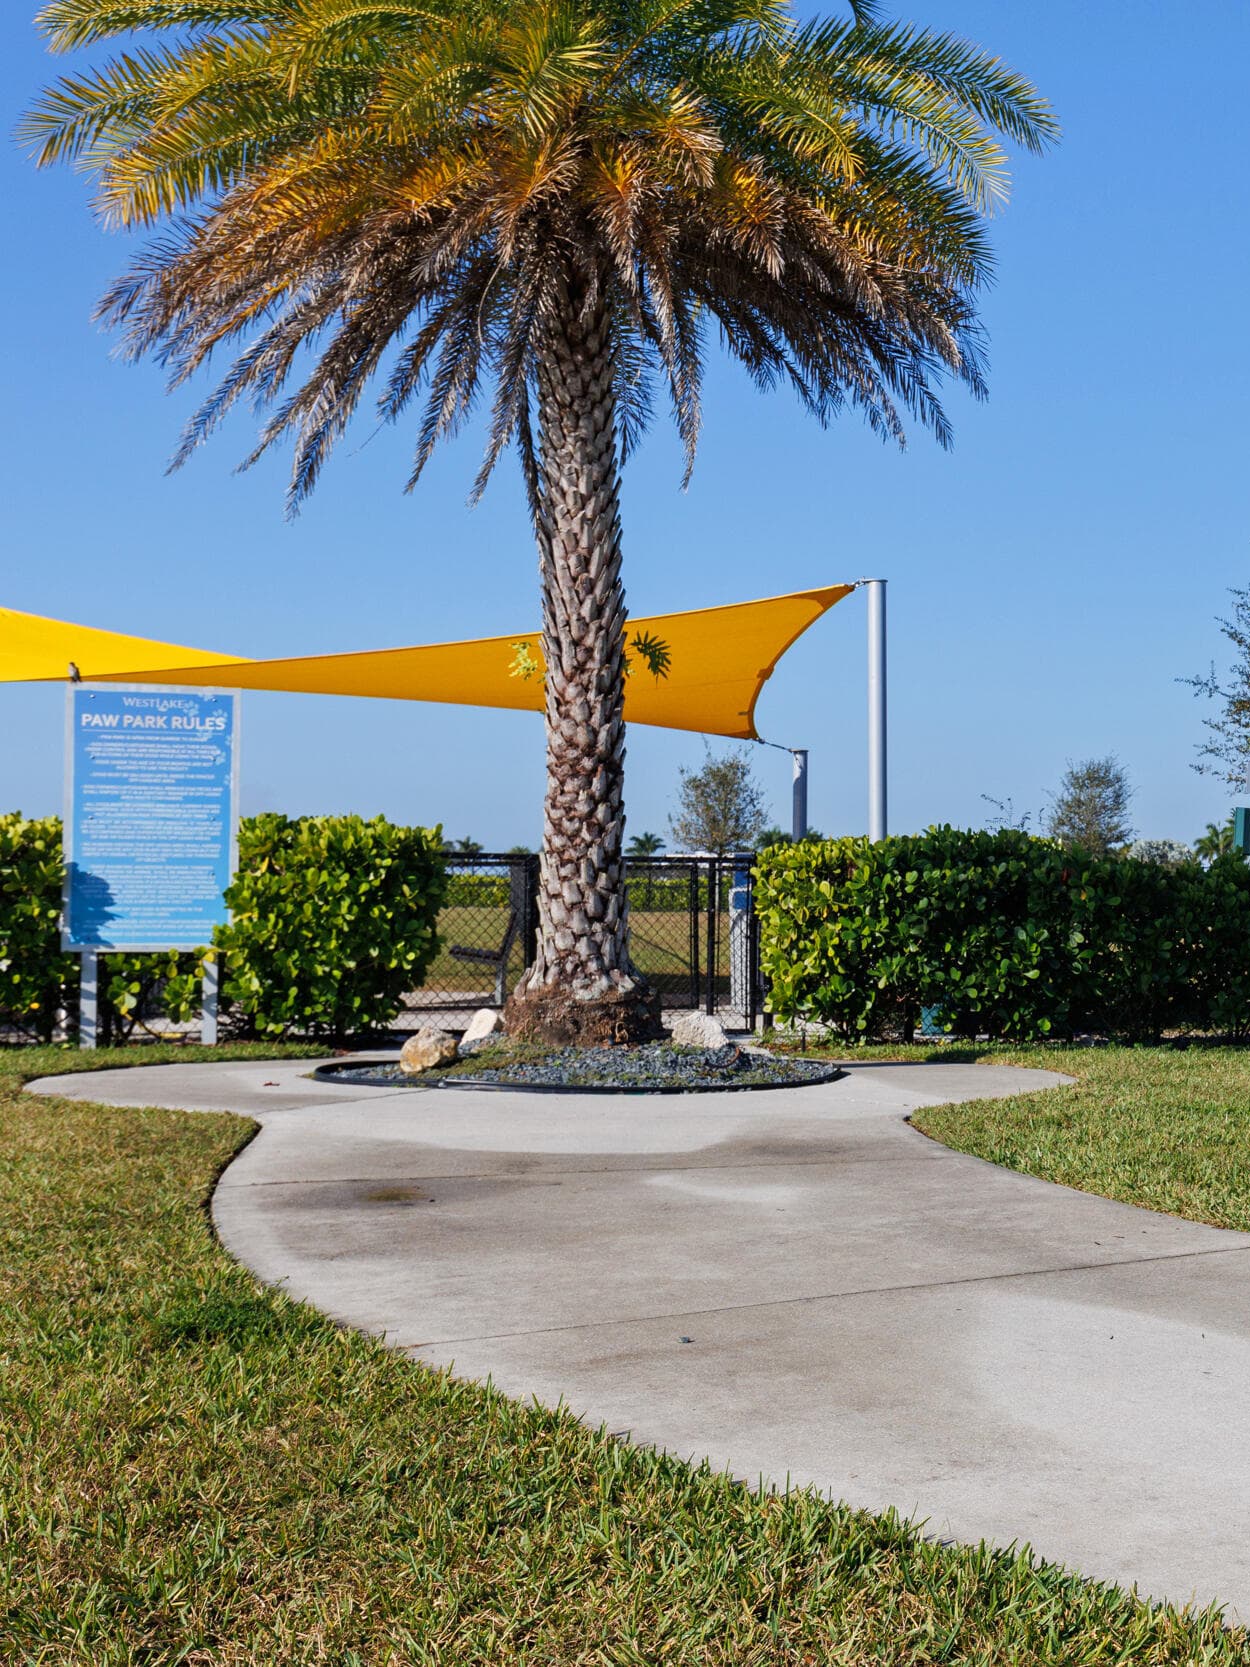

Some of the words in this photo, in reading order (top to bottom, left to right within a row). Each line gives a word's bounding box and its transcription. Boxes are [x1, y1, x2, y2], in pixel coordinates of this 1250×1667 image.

[123, 697, 185, 711] WESTLAKE
[81, 713, 120, 727] PAW
[123, 714, 167, 728] PARK
[171, 716, 226, 730] RULES
